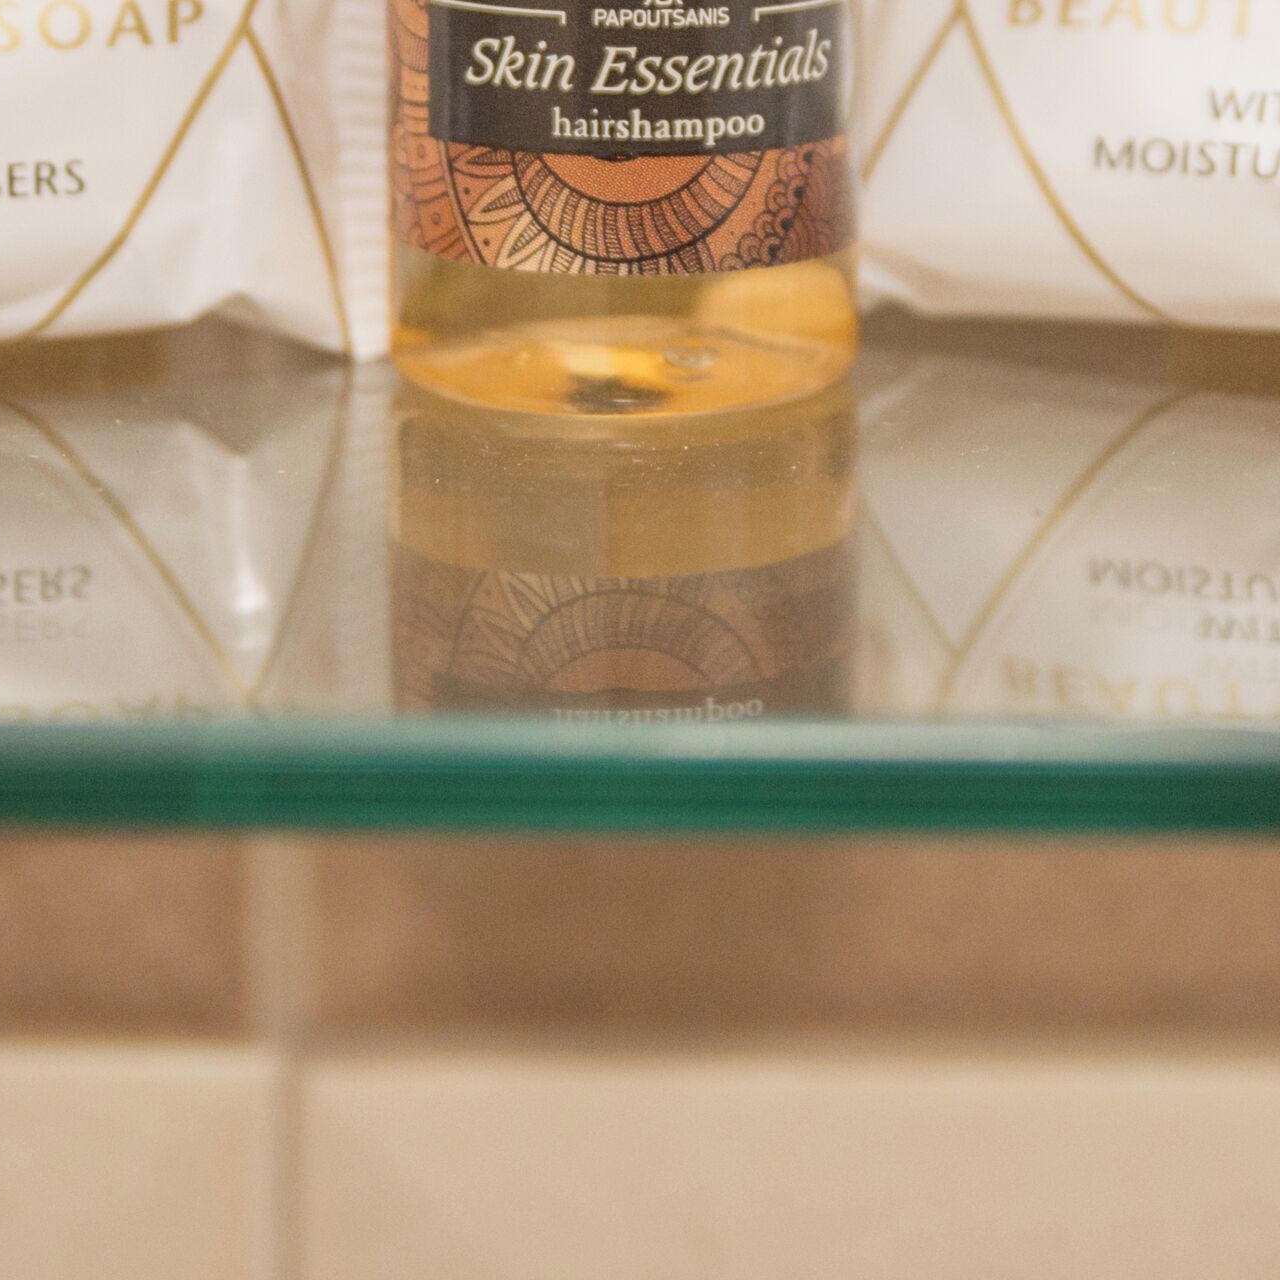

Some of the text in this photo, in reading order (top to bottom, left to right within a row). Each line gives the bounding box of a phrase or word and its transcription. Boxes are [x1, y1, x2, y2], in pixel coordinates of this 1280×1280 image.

[594, 7, 730, 28] PAPOUTSANIS
[465, 28, 831, 95] Skin Essentials
[553, 107, 765, 146] hairshampoo
